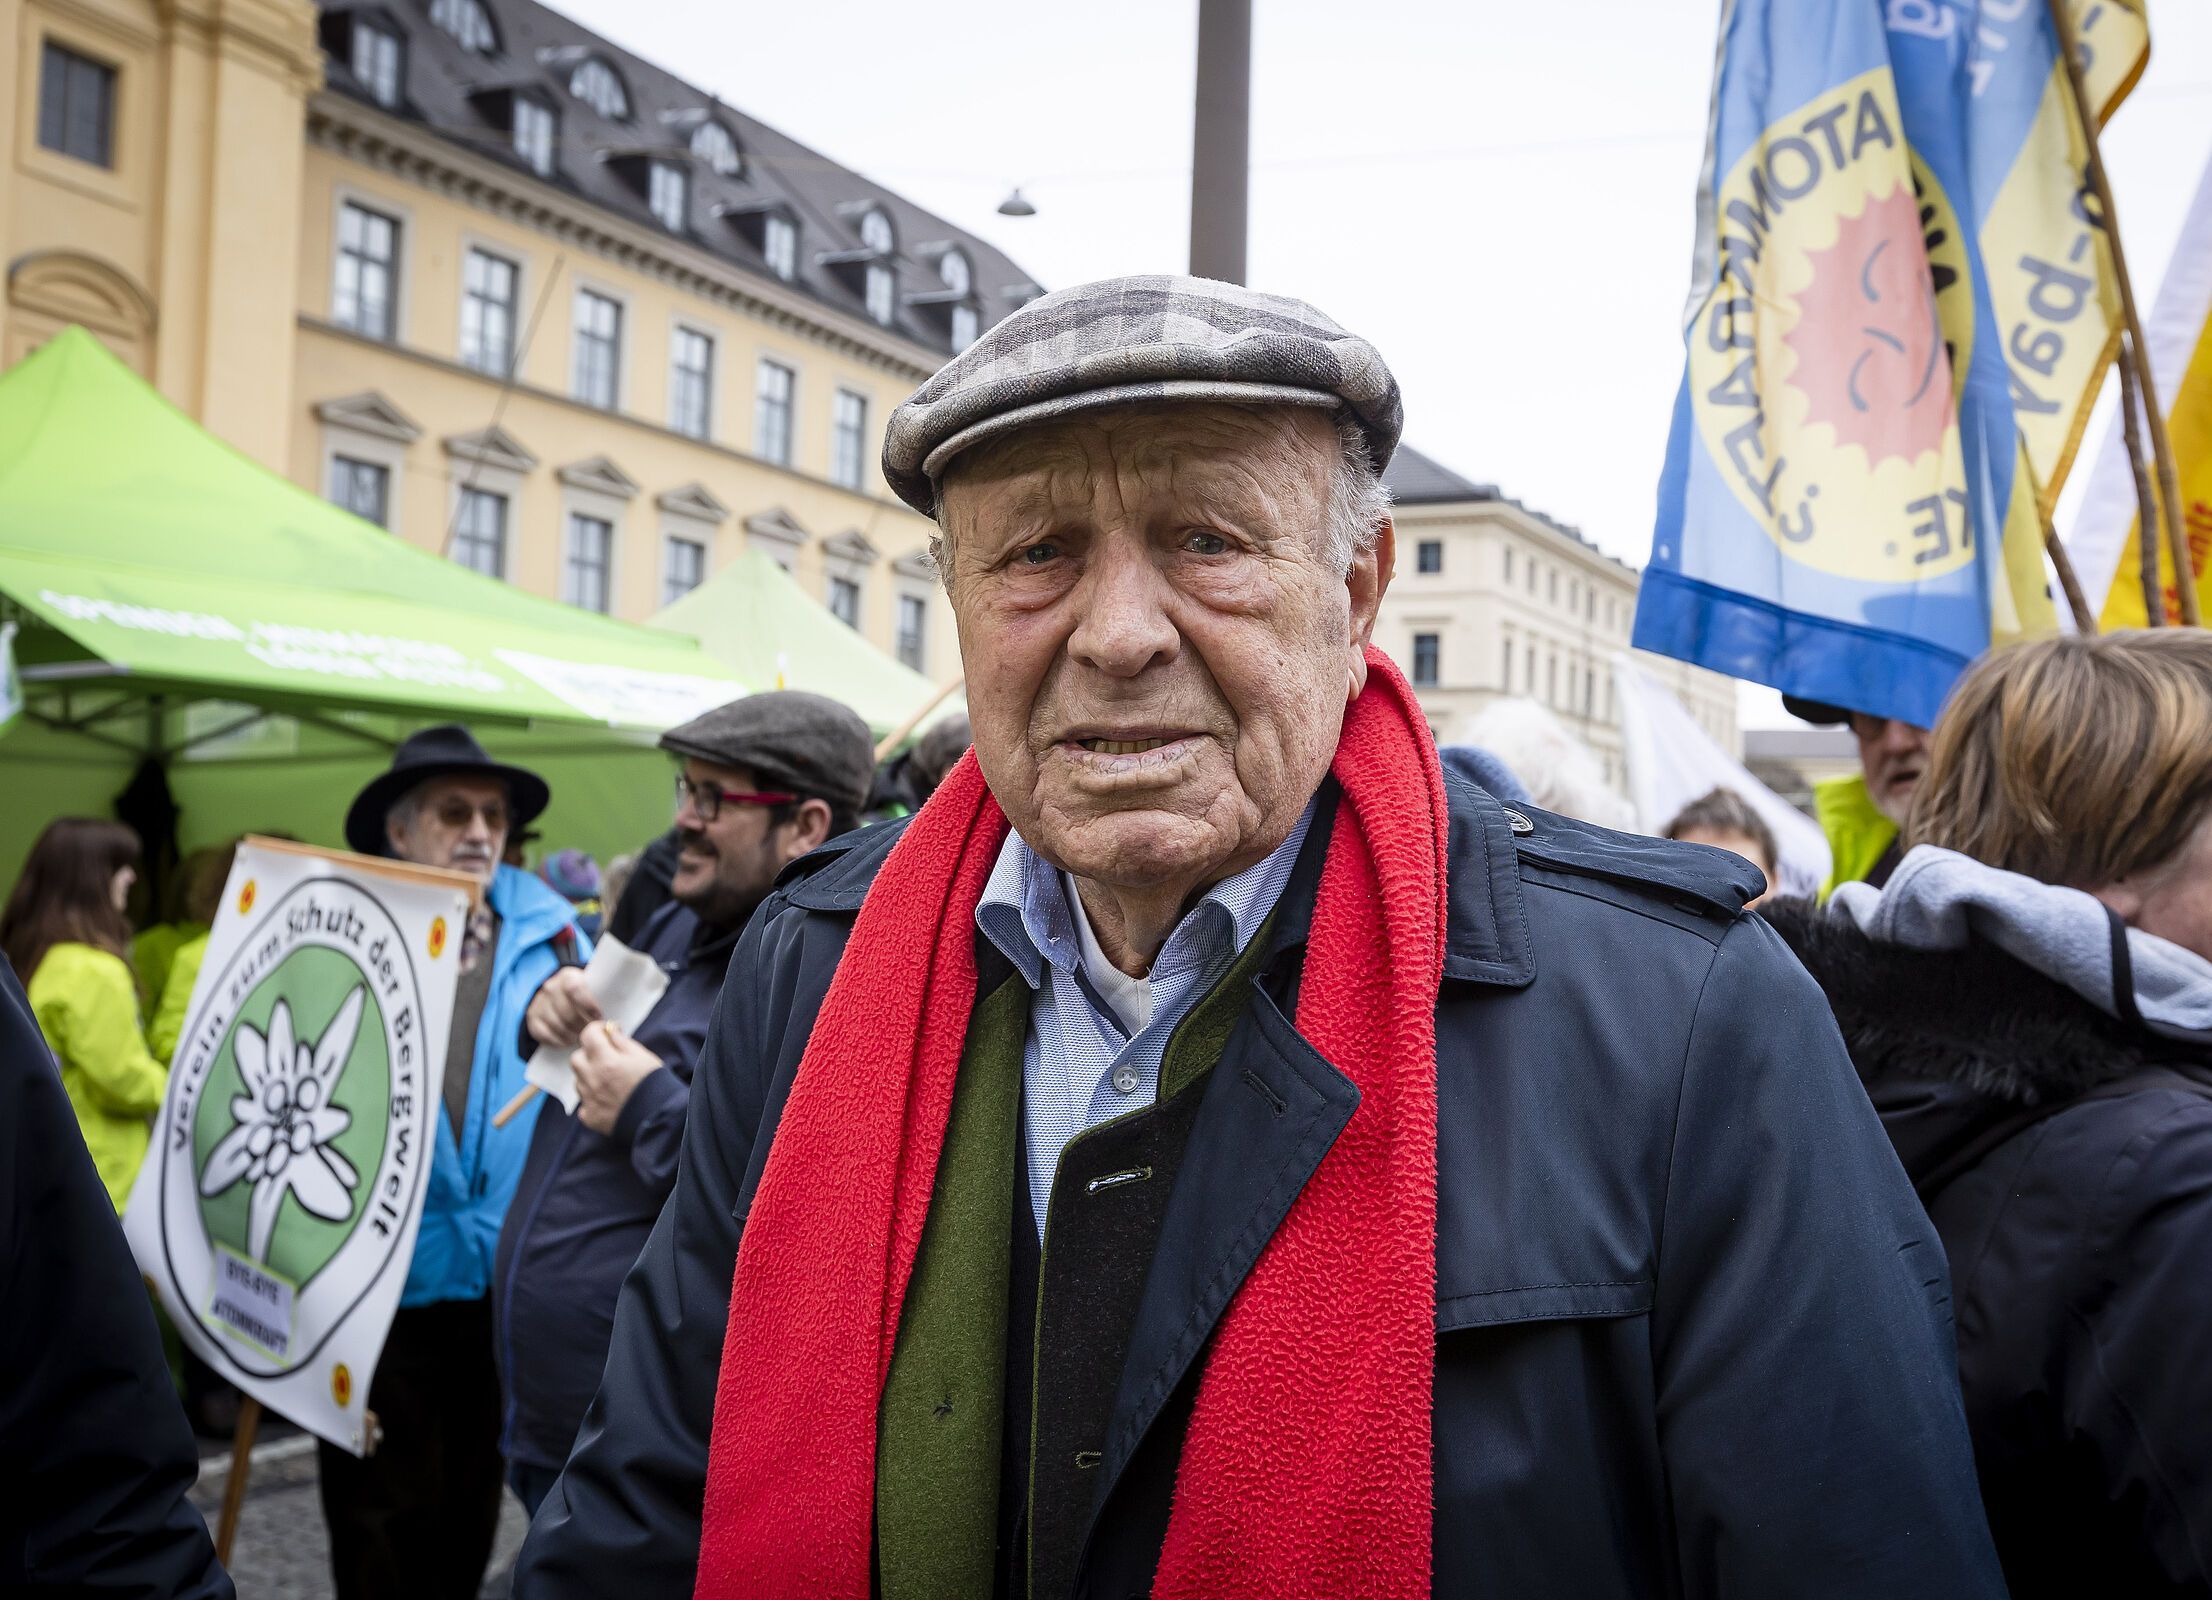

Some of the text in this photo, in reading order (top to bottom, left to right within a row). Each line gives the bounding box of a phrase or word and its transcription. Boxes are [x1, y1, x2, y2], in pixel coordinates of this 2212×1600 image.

[173, 898, 411, 1237] Verein zum Schutz der Bergwelt
